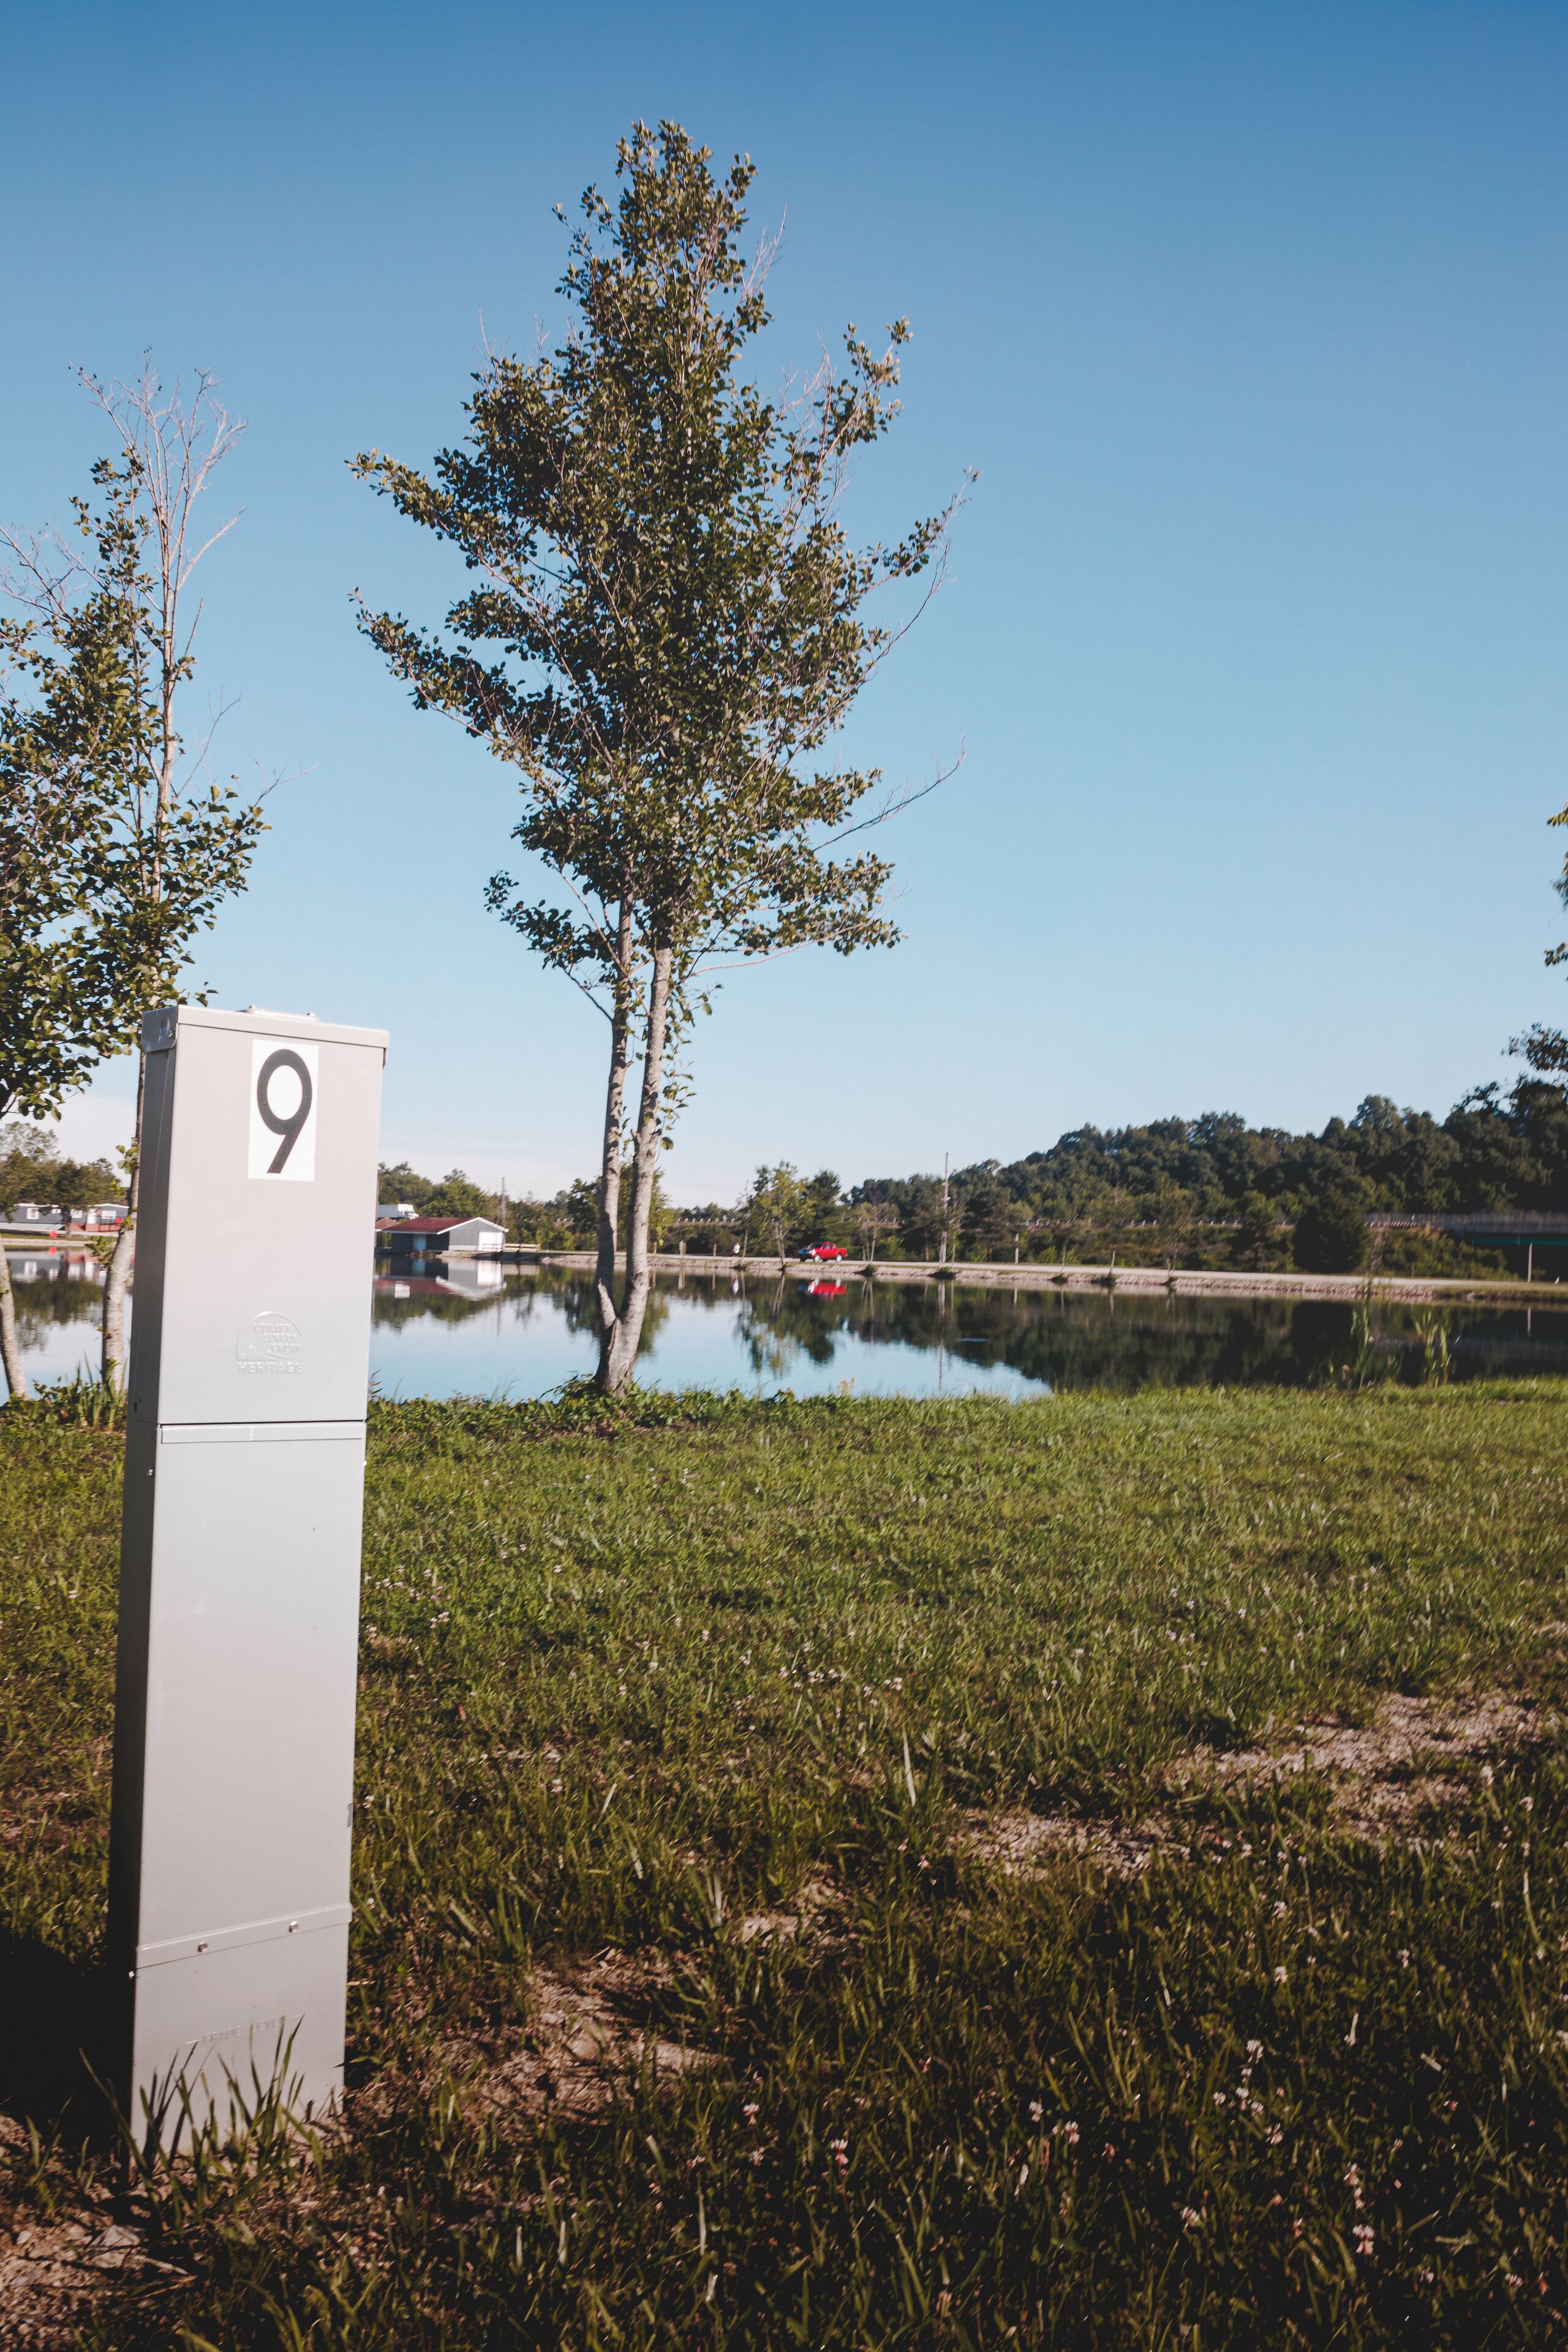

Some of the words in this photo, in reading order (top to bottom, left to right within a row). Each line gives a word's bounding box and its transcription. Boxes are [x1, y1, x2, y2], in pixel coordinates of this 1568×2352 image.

[257, 1049, 312, 1174] 9
[254, 1322, 292, 1333] UTILITY
[263, 1332, 297, 1343] SUPPLY
[271, 1342, 301, 1352] GROUP
[238, 1362, 303, 1374] HERITAGE
[249, 2016, 288, 2034] EVE
